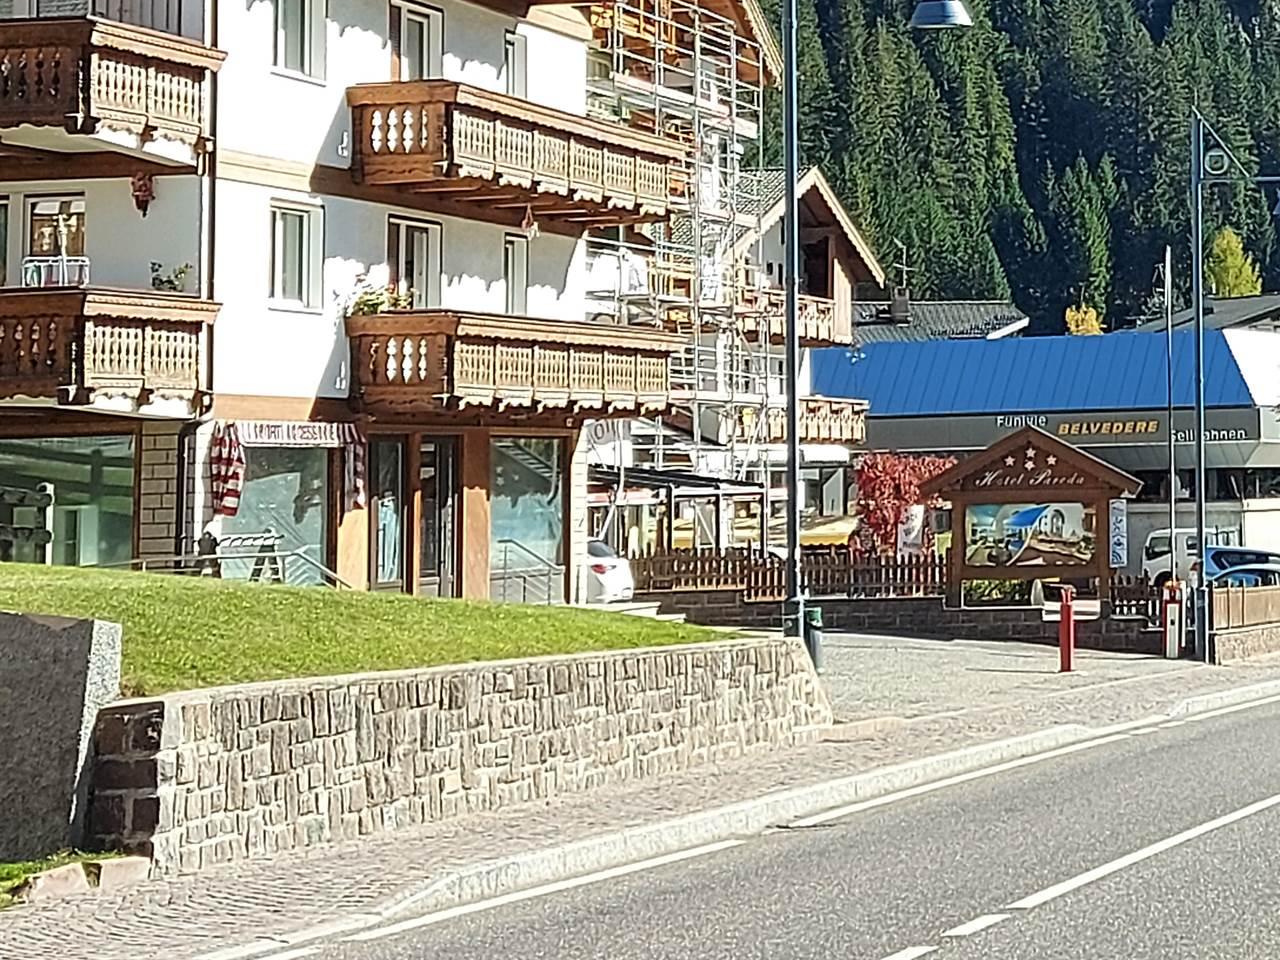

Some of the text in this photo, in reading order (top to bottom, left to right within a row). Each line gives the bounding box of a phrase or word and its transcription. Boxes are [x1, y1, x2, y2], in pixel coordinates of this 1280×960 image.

[1057, 420, 1159, 436] BELVEDERE
[1171, 428, 1247, 441] Seilahnen
[975, 469, 1024, 486] Hotel
